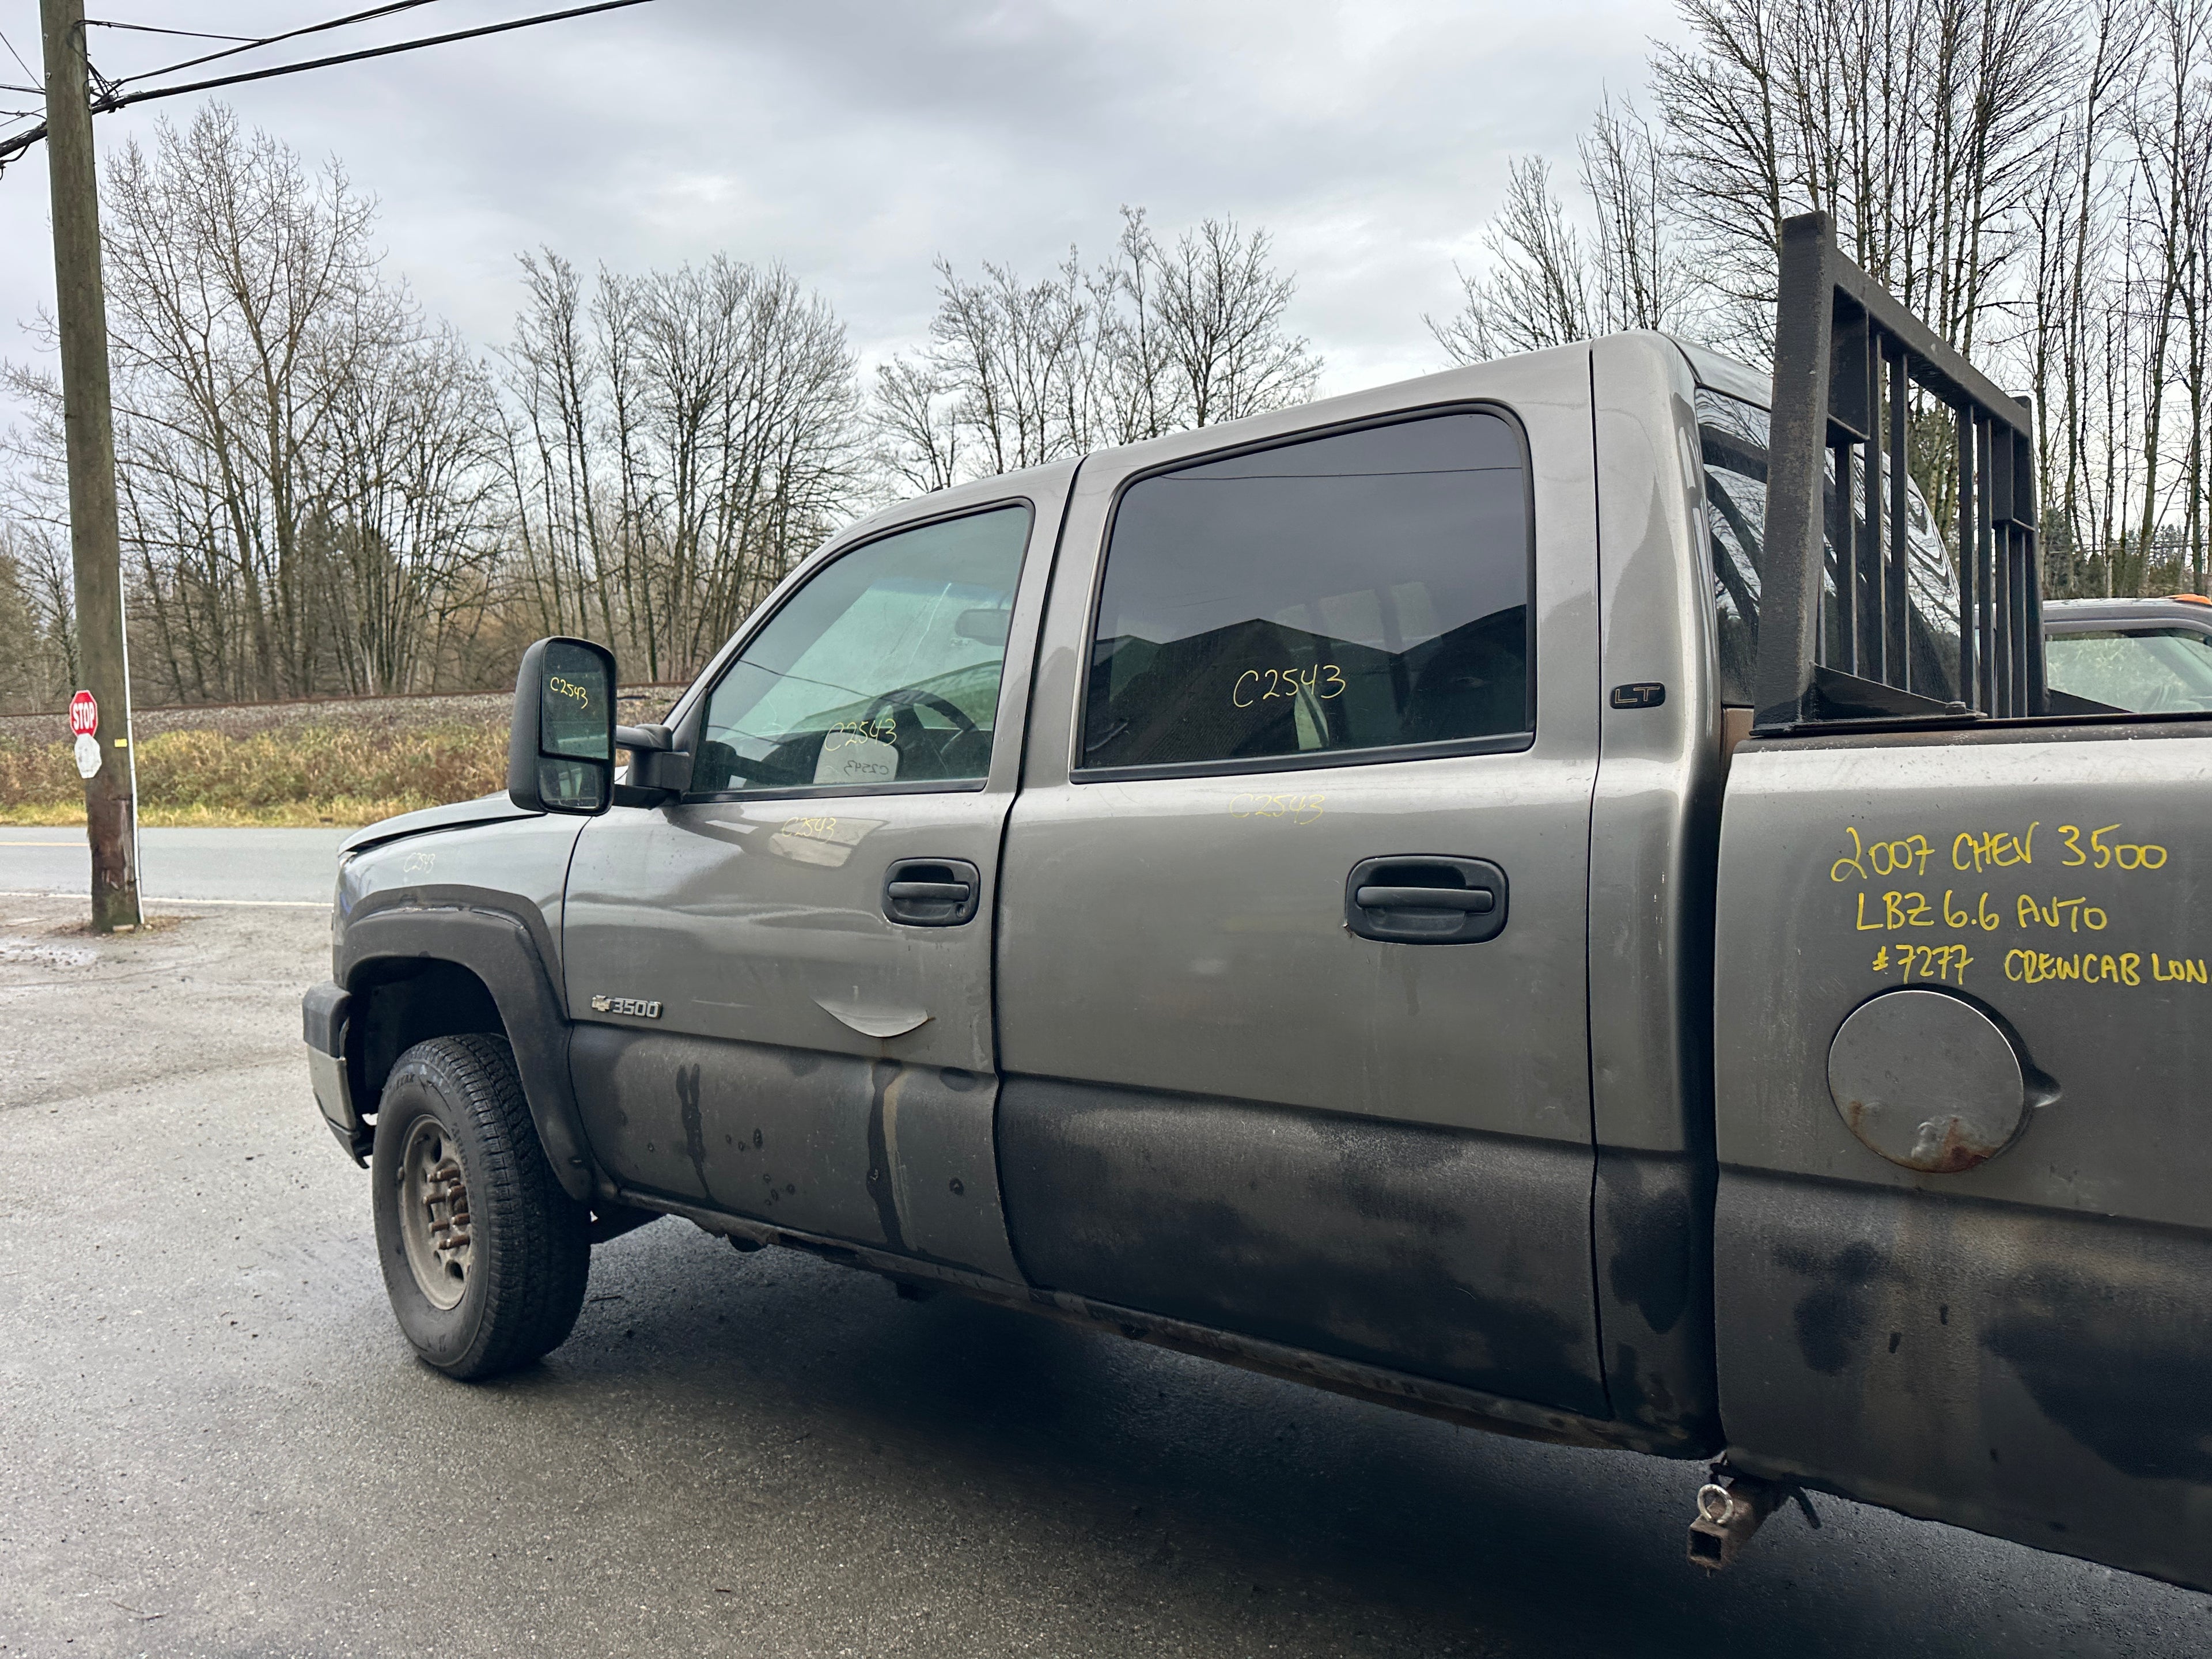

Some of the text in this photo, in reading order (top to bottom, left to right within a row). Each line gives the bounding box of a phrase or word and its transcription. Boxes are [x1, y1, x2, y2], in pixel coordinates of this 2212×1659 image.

[550, 677, 588, 709] C2543
[1233, 664, 1346, 707] C2543
[1615, 686, 1660, 703] LT
[73, 702, 95, 730] STOP
[824, 718, 897, 751] C2543
[1229, 793, 1325, 825] C2543
[782, 817, 836, 844] C2543
[1831, 821, 2167, 881] 2007 CHEV 3500
[1857, 890, 2108, 932] LBZ 6.6 AUTO
[1872, 944, 1974, 984] #7277
[2151, 953, 2212, 984] LON
[612, 998, 662, 1018] 3500
